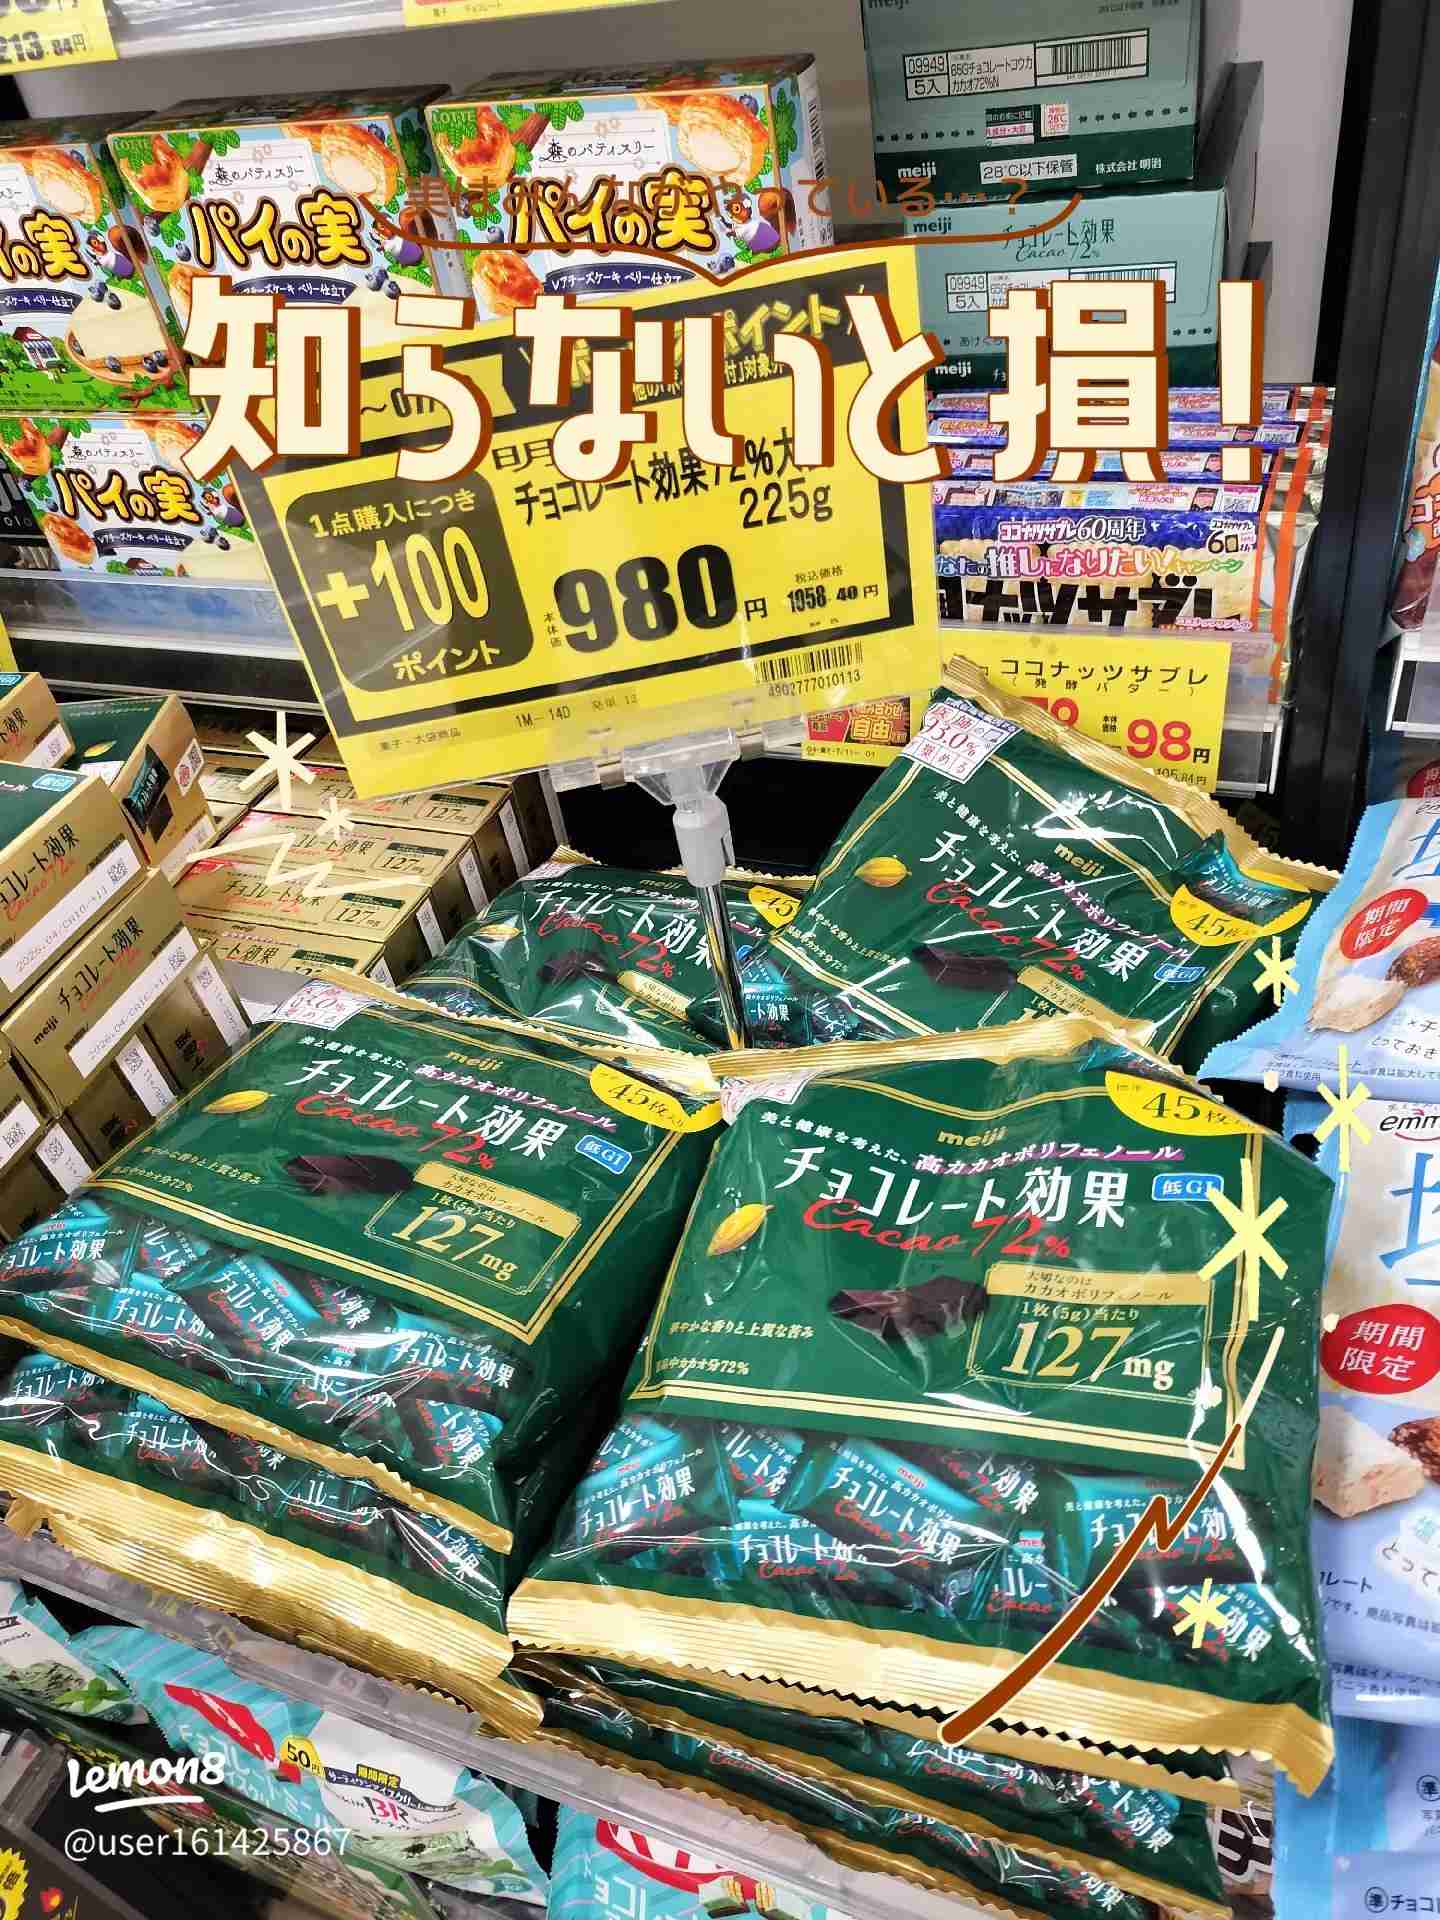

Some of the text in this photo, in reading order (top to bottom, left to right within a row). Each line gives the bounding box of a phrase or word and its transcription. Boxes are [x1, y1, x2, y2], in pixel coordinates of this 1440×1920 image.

[908, 56, 945, 74] 09949
[914, 79, 941, 95] 5入
[539, 140, 656, 163] 森のパティスリー
[209, 165, 305, 186] 森のパティスリー
[897, 164, 937, 180] meiji
[188, 190, 372, 270] パイの実
[912, 218, 952, 235] meiji
[955, 295, 981, 309] 5入
[934, 360, 972, 377] meiji
[54, 466, 203, 526] パイの実
[309, 487, 477, 539] 1点購入につき
[739, 476, 834, 529] 225g
[316, 526, 490, 637] +100
[393, 640, 501, 682] ポイント
[1001, 659, 1208, 687] ココナッツサブレ
[851, 717, 893, 741] 自由
[1054, 842, 1105, 878] meiji
[919, 829, 1149, 982] チョコレート効果
[33, 1015, 59, 1046] meiji
[447, 1049, 504, 1072] meiji
[284, 1059, 569, 1161] チョコレート効果
[412, 1062, 618, 1131] 高カカオポリフェノール
[295, 1092, 497, 1170] Cacao 72%
[759, 1110, 911, 1168] 美と健康を考えた、
[937, 1126, 1008, 1147] meiji
[912, 1141, 1185, 1178] 高カカオポリフェノール
[774, 1165, 1130, 1229] チョコレート効果
[391, 1206, 505, 1263] 127
[801, 1198, 1071, 1259] Cacao 72%
[1352, 1319, 1425, 1351] 期間
[1001, 1319, 1176, 1392] 127 mg
[1340, 1346, 1416, 1382] 限定
